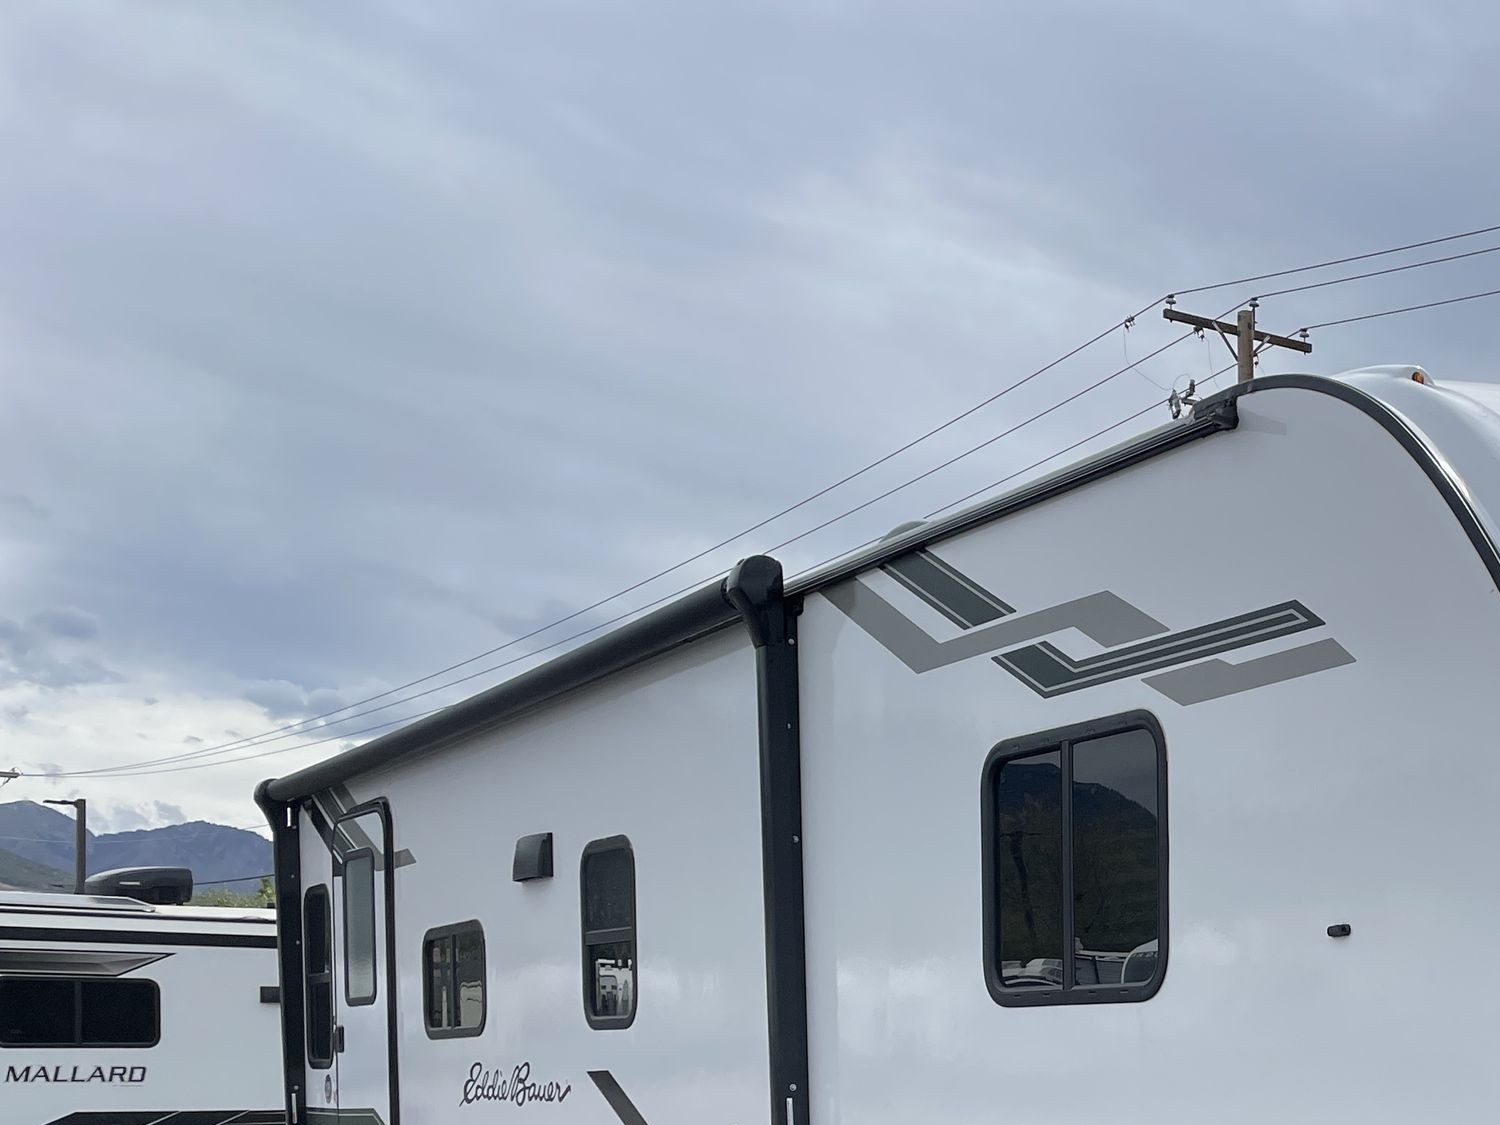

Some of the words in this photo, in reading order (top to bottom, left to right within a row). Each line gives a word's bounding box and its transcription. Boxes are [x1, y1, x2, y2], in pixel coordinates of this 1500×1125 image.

[5, 1065, 147, 1083] MALLARD
[459, 1061, 508, 1107] Eddie
[508, 1061, 571, 1107] Bauer
